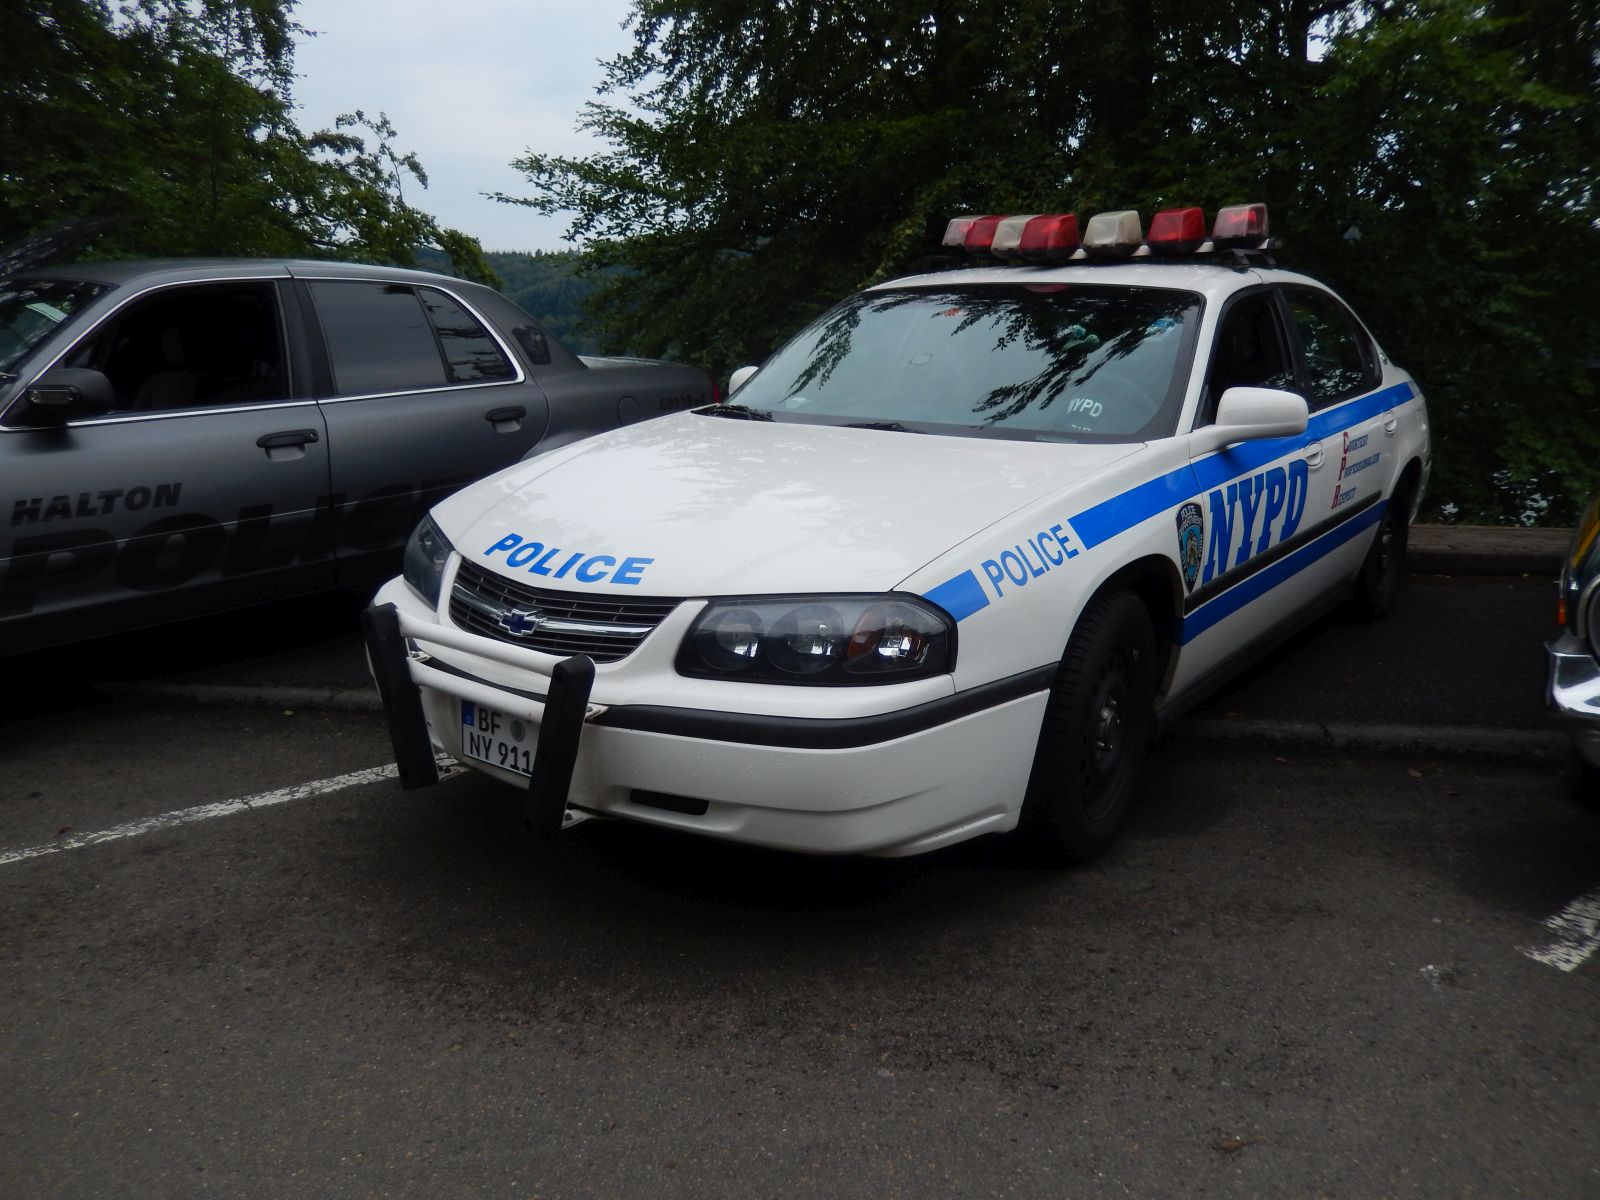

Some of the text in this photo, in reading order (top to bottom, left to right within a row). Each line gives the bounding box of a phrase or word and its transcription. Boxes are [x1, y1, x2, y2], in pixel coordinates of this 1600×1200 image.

[10, 482, 182, 526] HALTON
[1202, 459, 1308, 586] NYPD
[484, 533, 654, 585] POLICE
[981, 524, 1079, 598] POLICE
[478, 707, 502, 735] BF
[470, 731, 532, 774] NY 911
